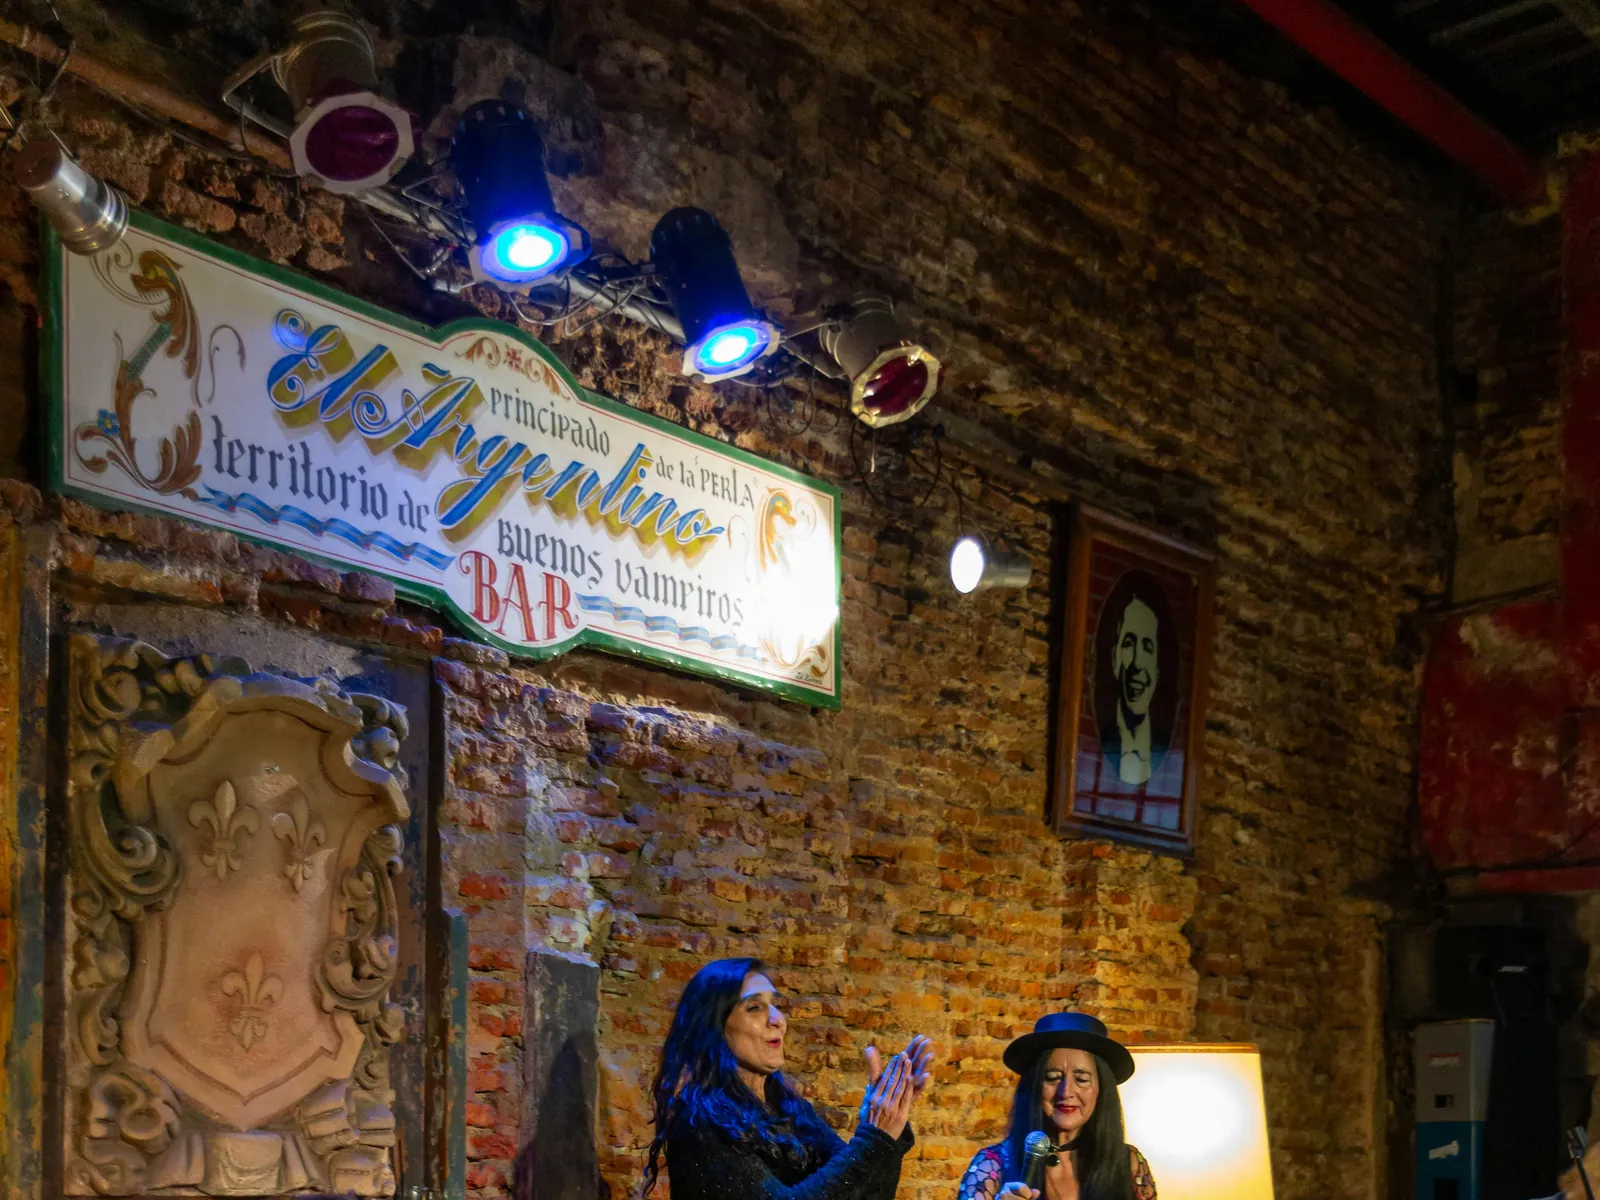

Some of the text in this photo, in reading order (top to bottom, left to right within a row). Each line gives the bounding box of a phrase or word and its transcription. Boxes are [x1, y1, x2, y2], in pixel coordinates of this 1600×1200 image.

[267, 308, 391, 423] El
[212, 415, 430, 533] territorio de
[491, 387, 610, 457] principado
[656, 456, 674, 481] de
[680, 460, 696, 489] la
[459, 550, 579, 643] BAR
